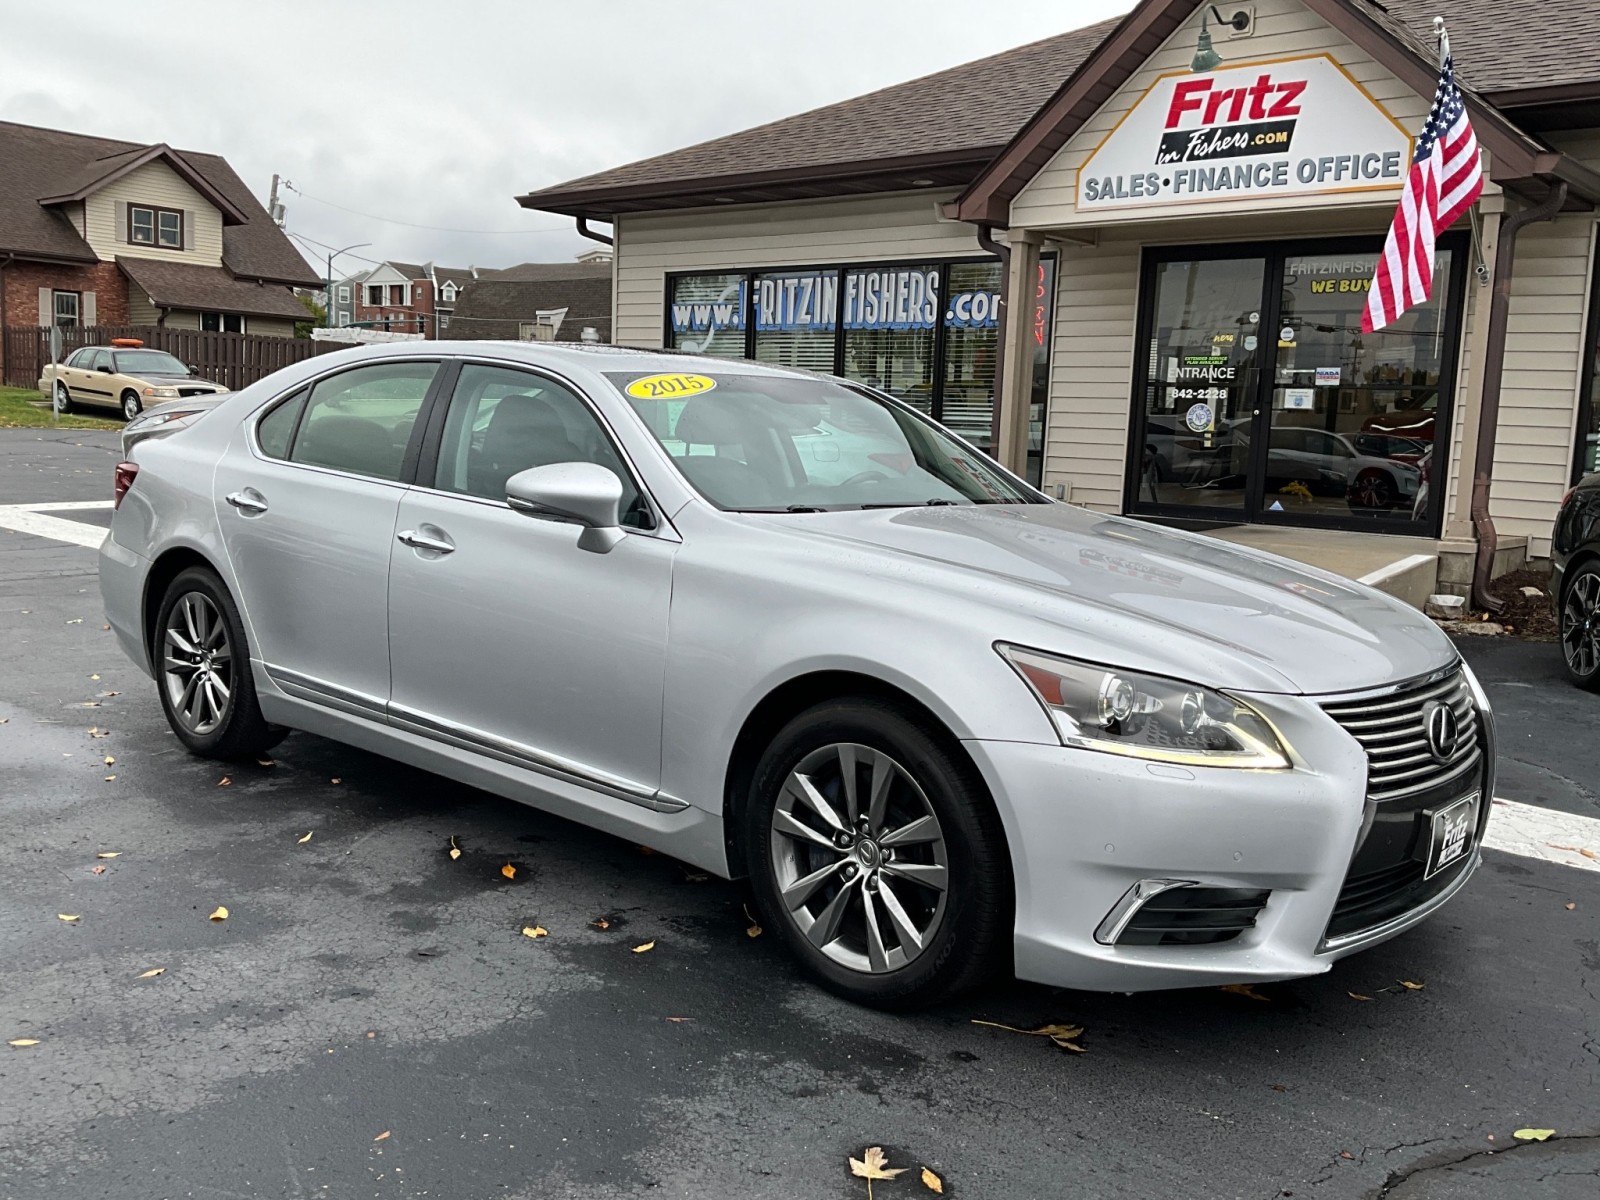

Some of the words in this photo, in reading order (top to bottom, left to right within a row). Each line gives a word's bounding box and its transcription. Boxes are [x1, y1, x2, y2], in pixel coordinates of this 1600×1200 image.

[1165, 74, 1308, 129] Fritz
[1159, 145, 1181, 164] in
[1085, 172, 1160, 201] SALES
[1173, 161, 1289, 194] FINANCE
[1296, 151, 1401, 183] OFFICE
[1311, 280, 1336, 294] WE
[1168, 367, 1235, 378] ENTRANCE
[643, 376, 704, 396] 2015
[1171, 389, 1227, 399] 842-2228
